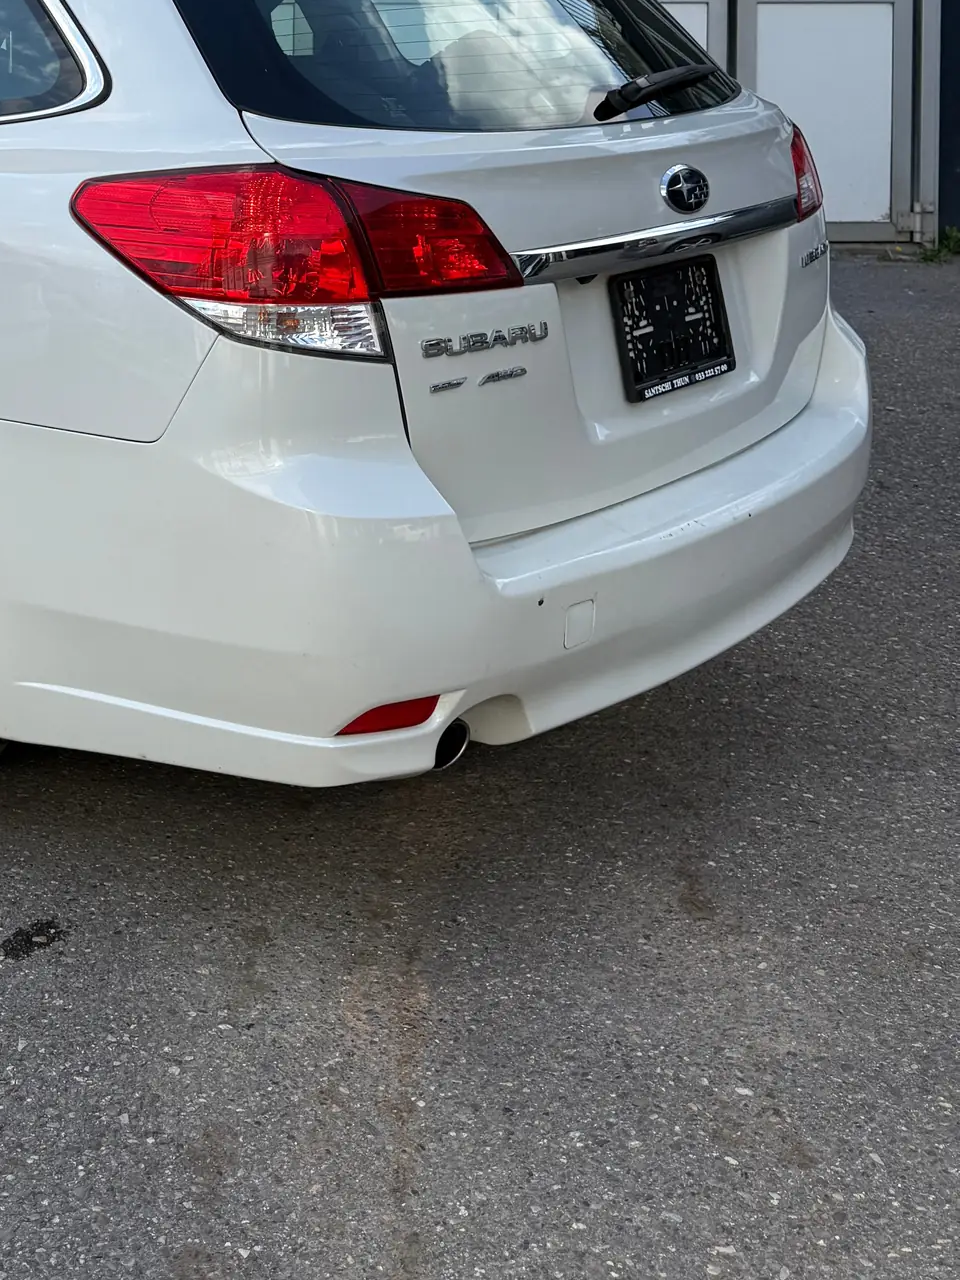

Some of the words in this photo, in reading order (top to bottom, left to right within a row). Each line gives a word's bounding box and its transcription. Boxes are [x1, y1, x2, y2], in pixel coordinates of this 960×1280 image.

[421, 319, 549, 359] SUBARU
[644, 381, 672, 399] SANTSCHI
[672, 375, 690, 389] THUN
